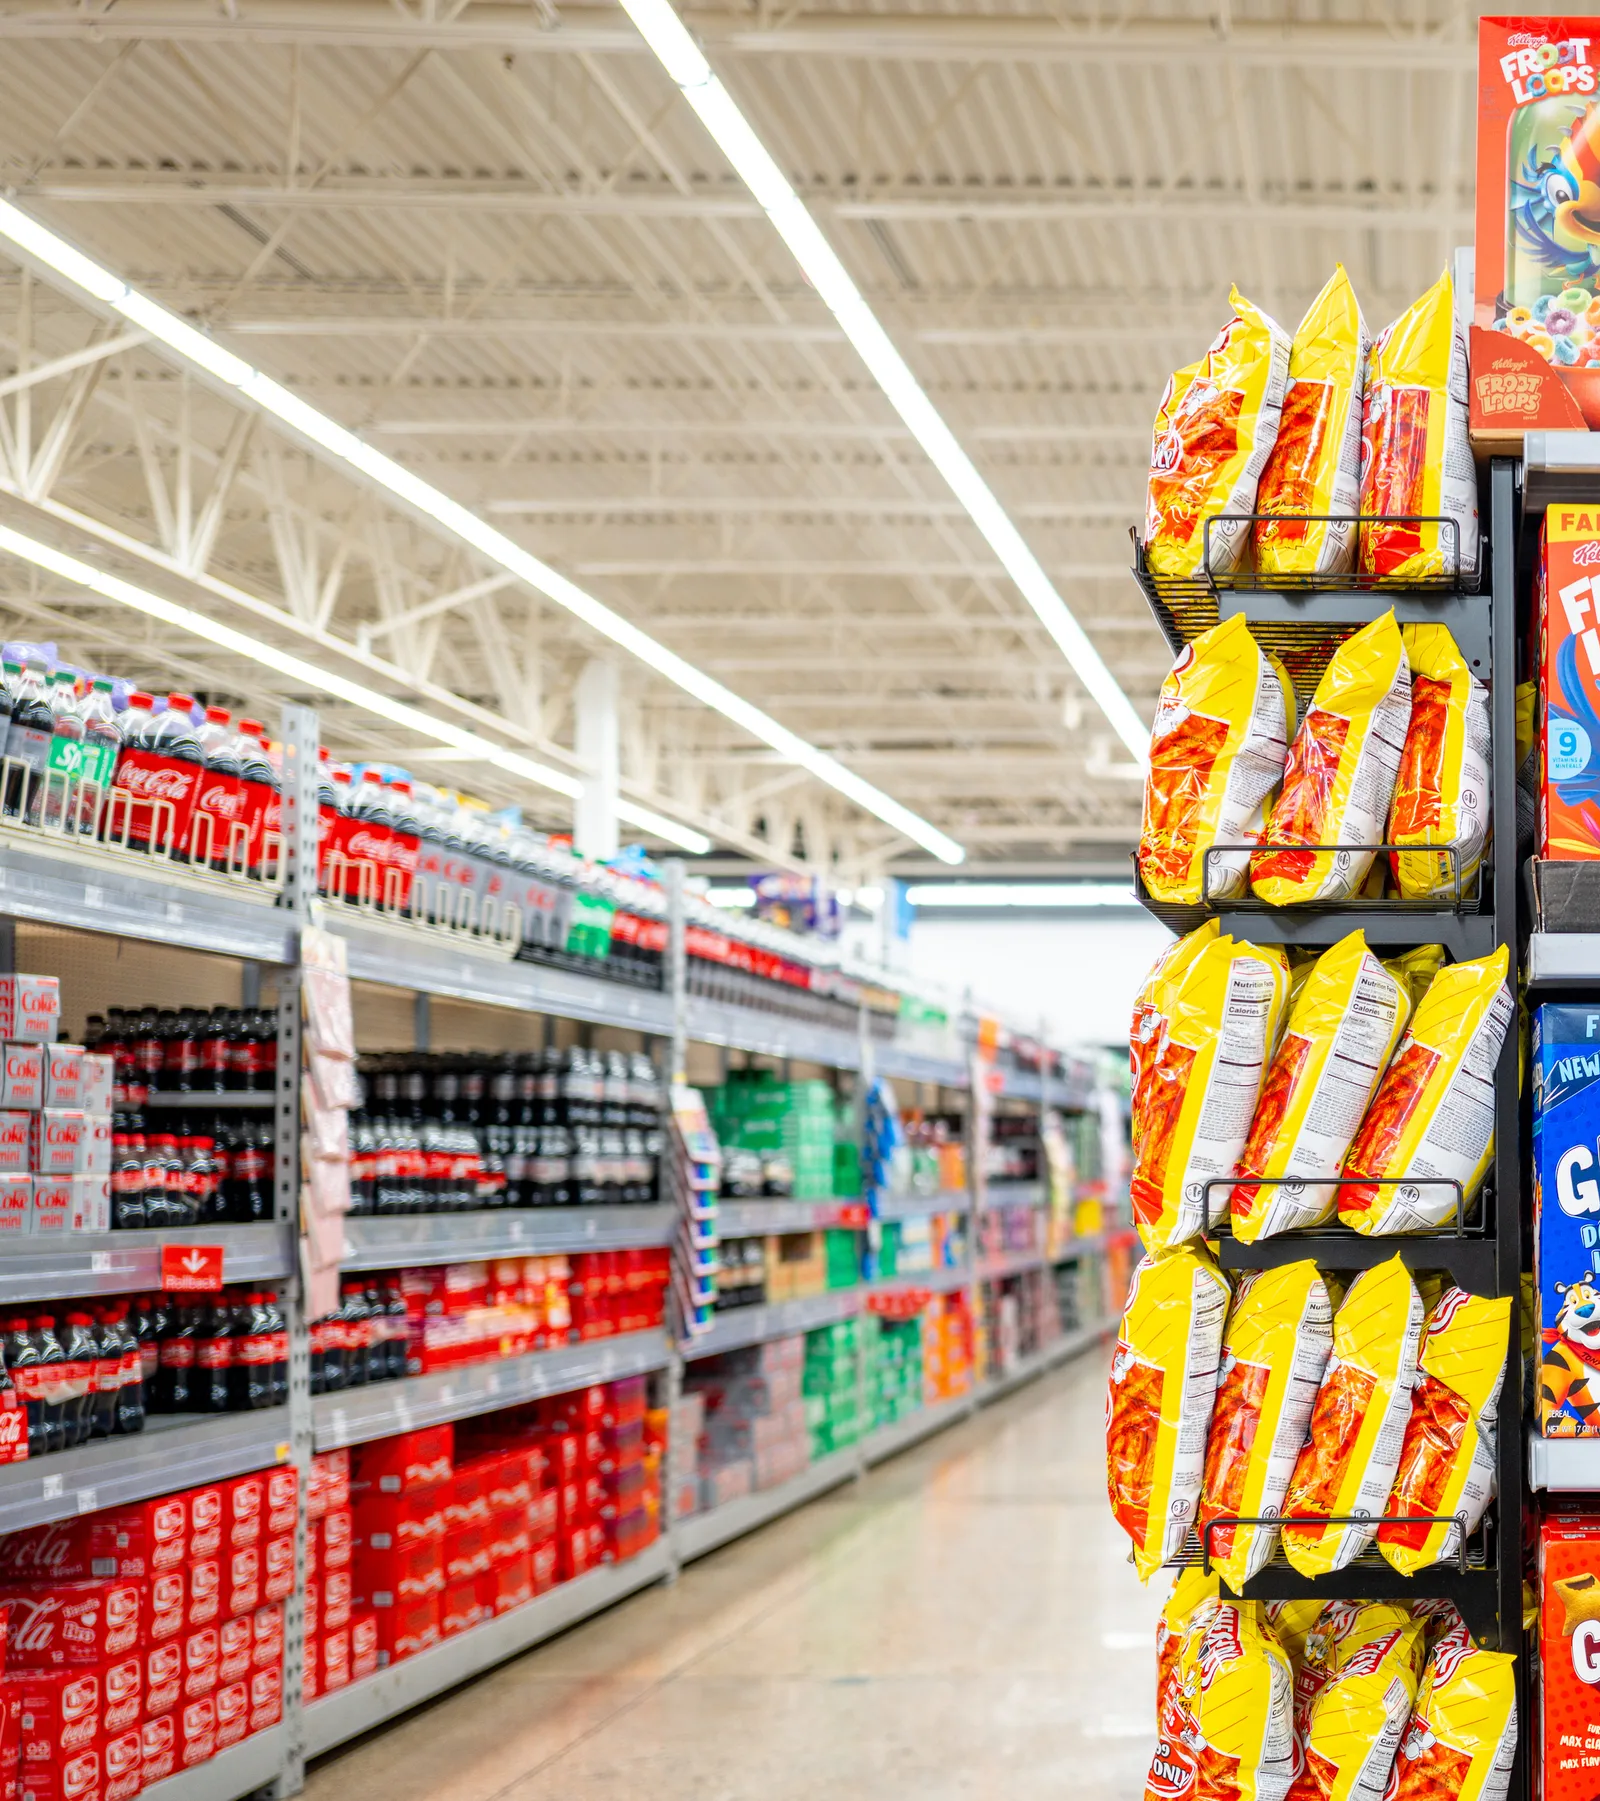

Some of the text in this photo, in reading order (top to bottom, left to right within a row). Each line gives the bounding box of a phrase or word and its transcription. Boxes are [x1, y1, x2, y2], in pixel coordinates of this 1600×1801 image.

[1500, 37, 1591, 83] FROOT
[1511, 67, 1596, 103] LOOPS
[1559, 732, 1577, 755] 9
[1560, 1735, 1582, 1747] MAX
[1152, 1757, 1191, 1789] ONLY
